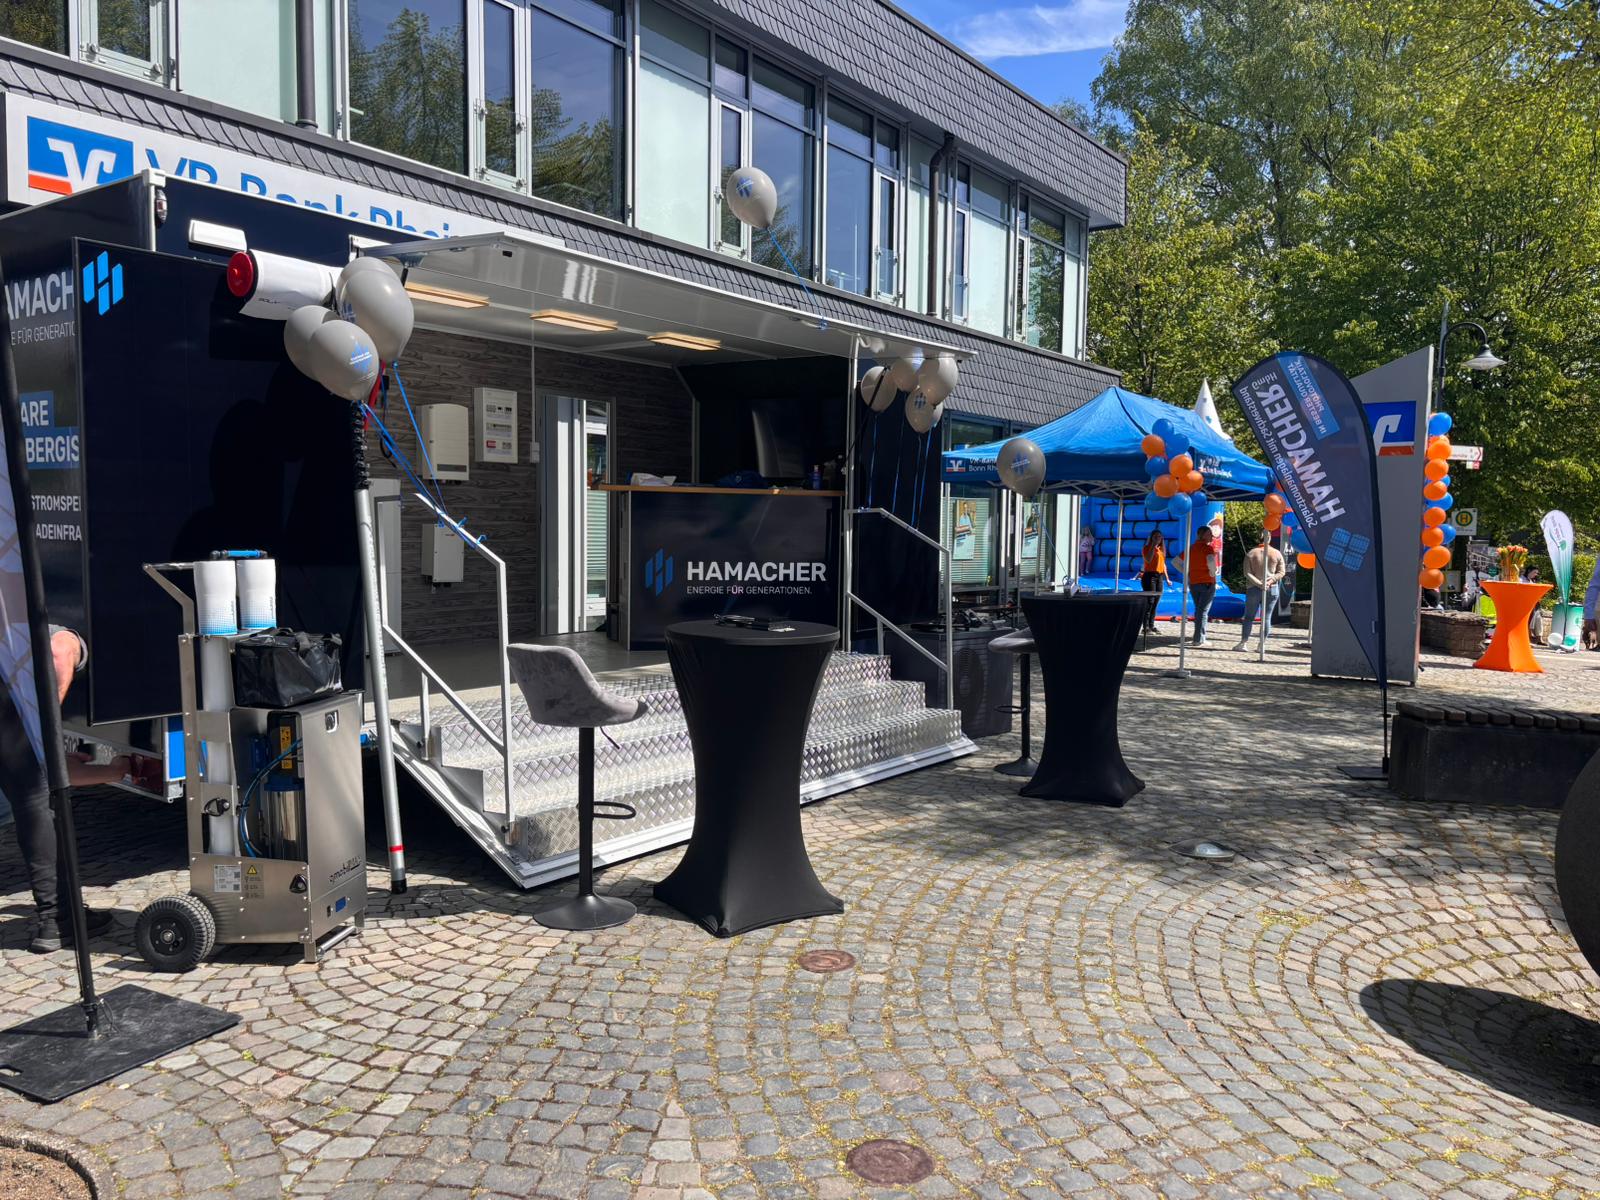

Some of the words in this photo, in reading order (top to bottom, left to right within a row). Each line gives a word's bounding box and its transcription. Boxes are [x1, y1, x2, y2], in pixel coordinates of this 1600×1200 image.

[240, 172, 359, 220] Bk
[369, 206, 450, 240] Rh
[18, 327, 32, 344] FÜR
[25, 435, 80, 463] BERGIS
[686, 561, 827, 582] HAMACHER
[687, 585, 724, 595] ENERGIE
[726, 584, 744, 595] FÜR
[746, 585, 812, 595] GENERATIONEN.
